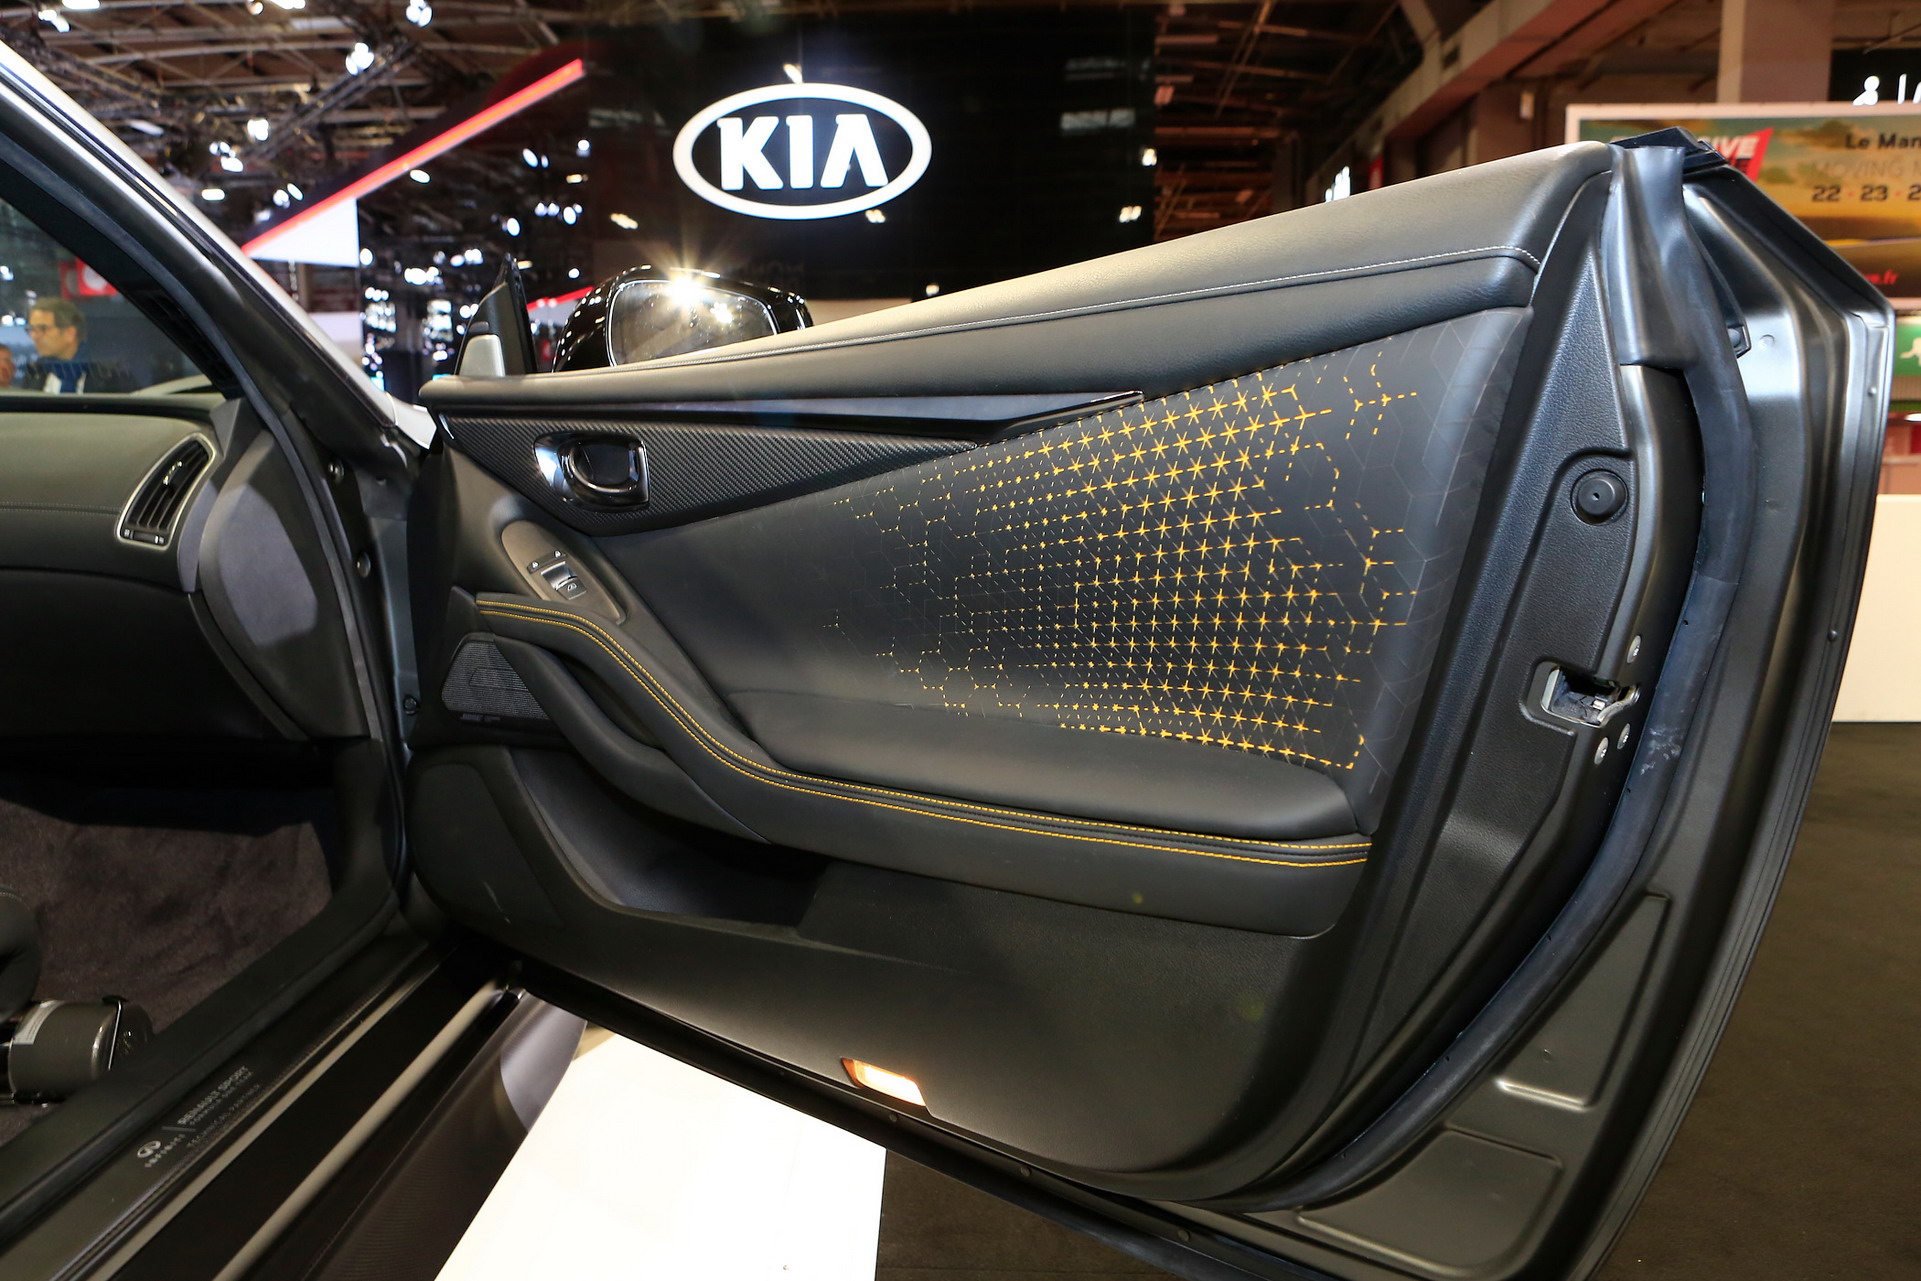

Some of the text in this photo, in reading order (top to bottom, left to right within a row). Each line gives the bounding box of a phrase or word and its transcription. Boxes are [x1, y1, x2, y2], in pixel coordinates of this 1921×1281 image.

[1845, 132, 1870, 150] Le
[716, 114, 889, 190] KIA
[1812, 160, 1905, 178] MOVING
[1811, 184, 1841, 202] 22
[1860, 184, 1889, 202] 23
